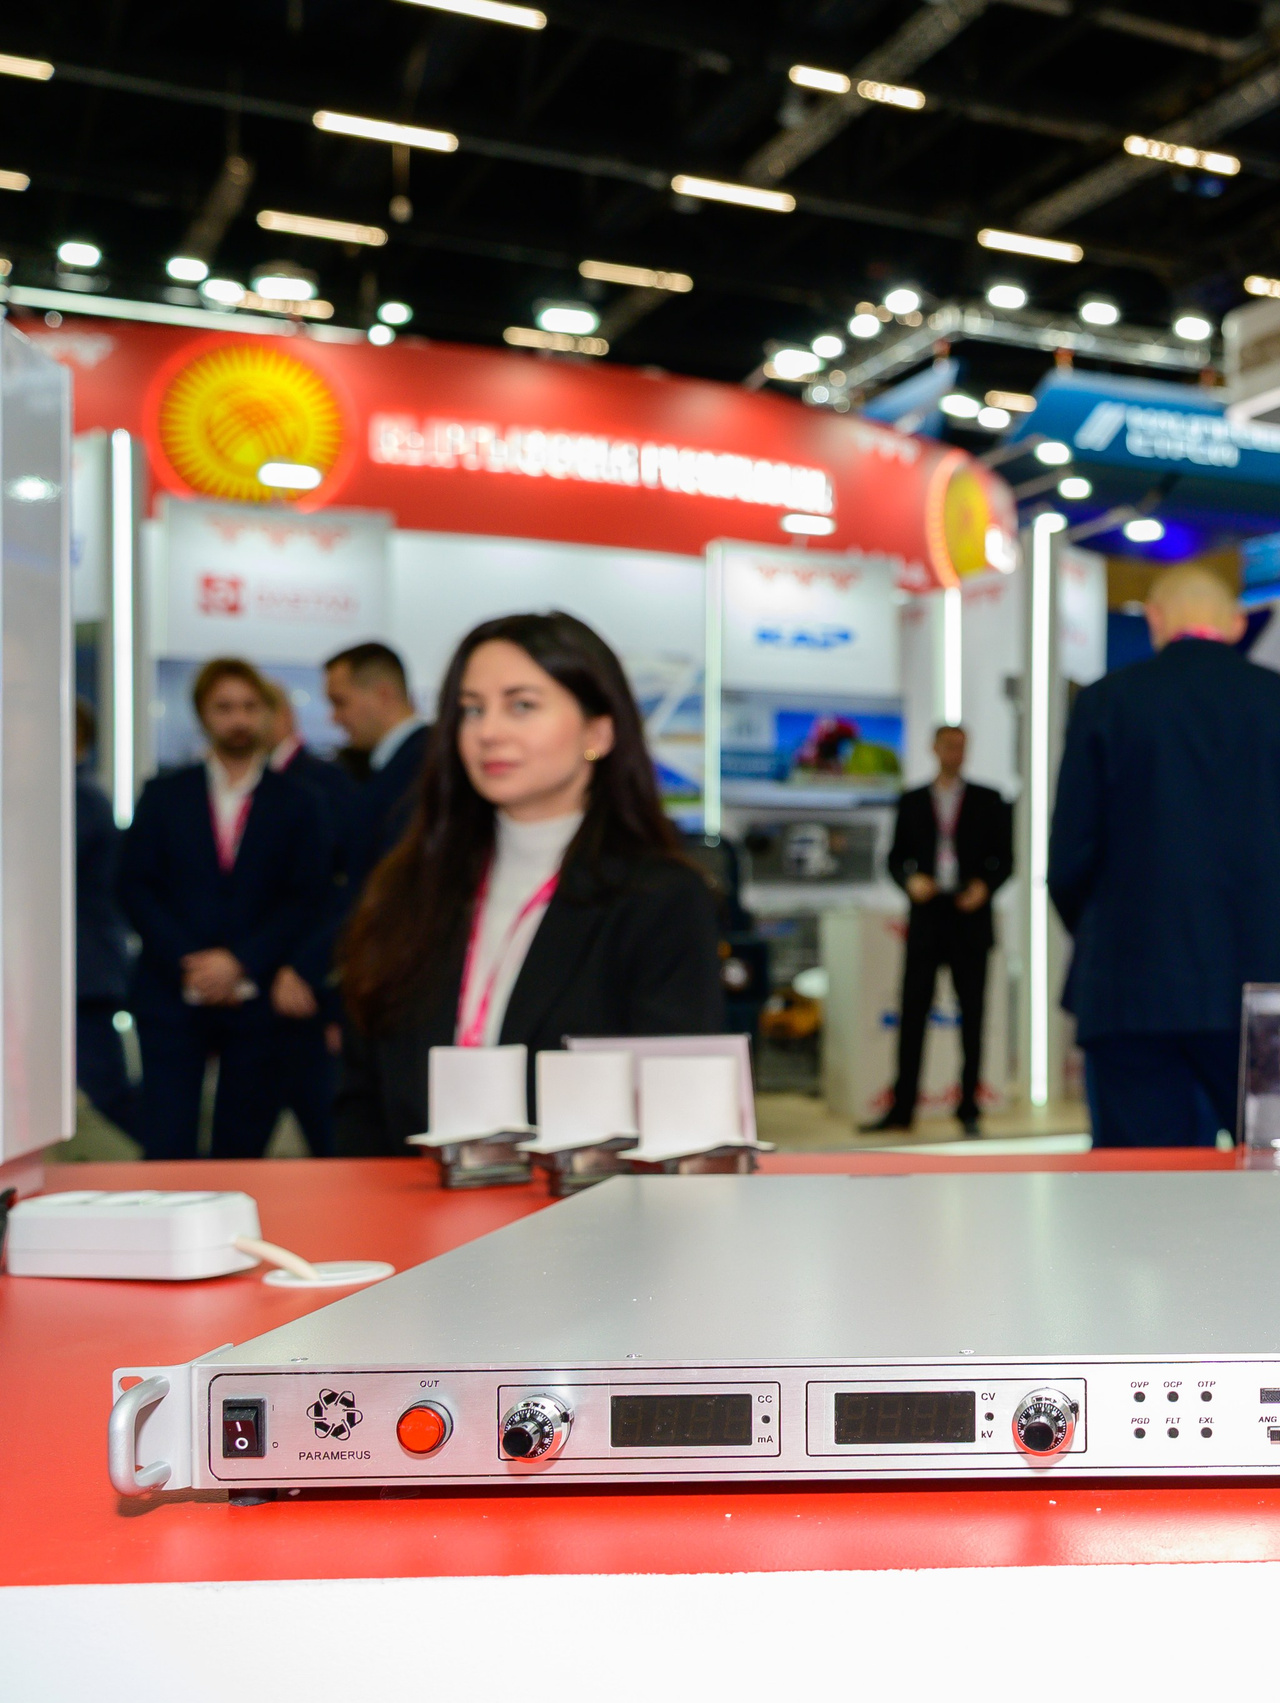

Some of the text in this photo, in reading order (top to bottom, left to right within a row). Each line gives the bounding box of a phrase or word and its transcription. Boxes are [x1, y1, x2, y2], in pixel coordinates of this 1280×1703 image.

[419, 1380, 440, 1388] OUT
[1130, 1381, 1149, 1389] OVP
[1163, 1381, 1183, 1389] OCP
[1197, 1380, 1216, 1388] OTP
[757, 1394, 773, 1404] CC
[981, 1392, 996, 1401] CV
[1131, 1417, 1150, 1425] PGD
[757, 1434, 774, 1443] mA
[981, 1430, 994, 1439] kV
[298, 1450, 371, 1461] PARAMERUS
